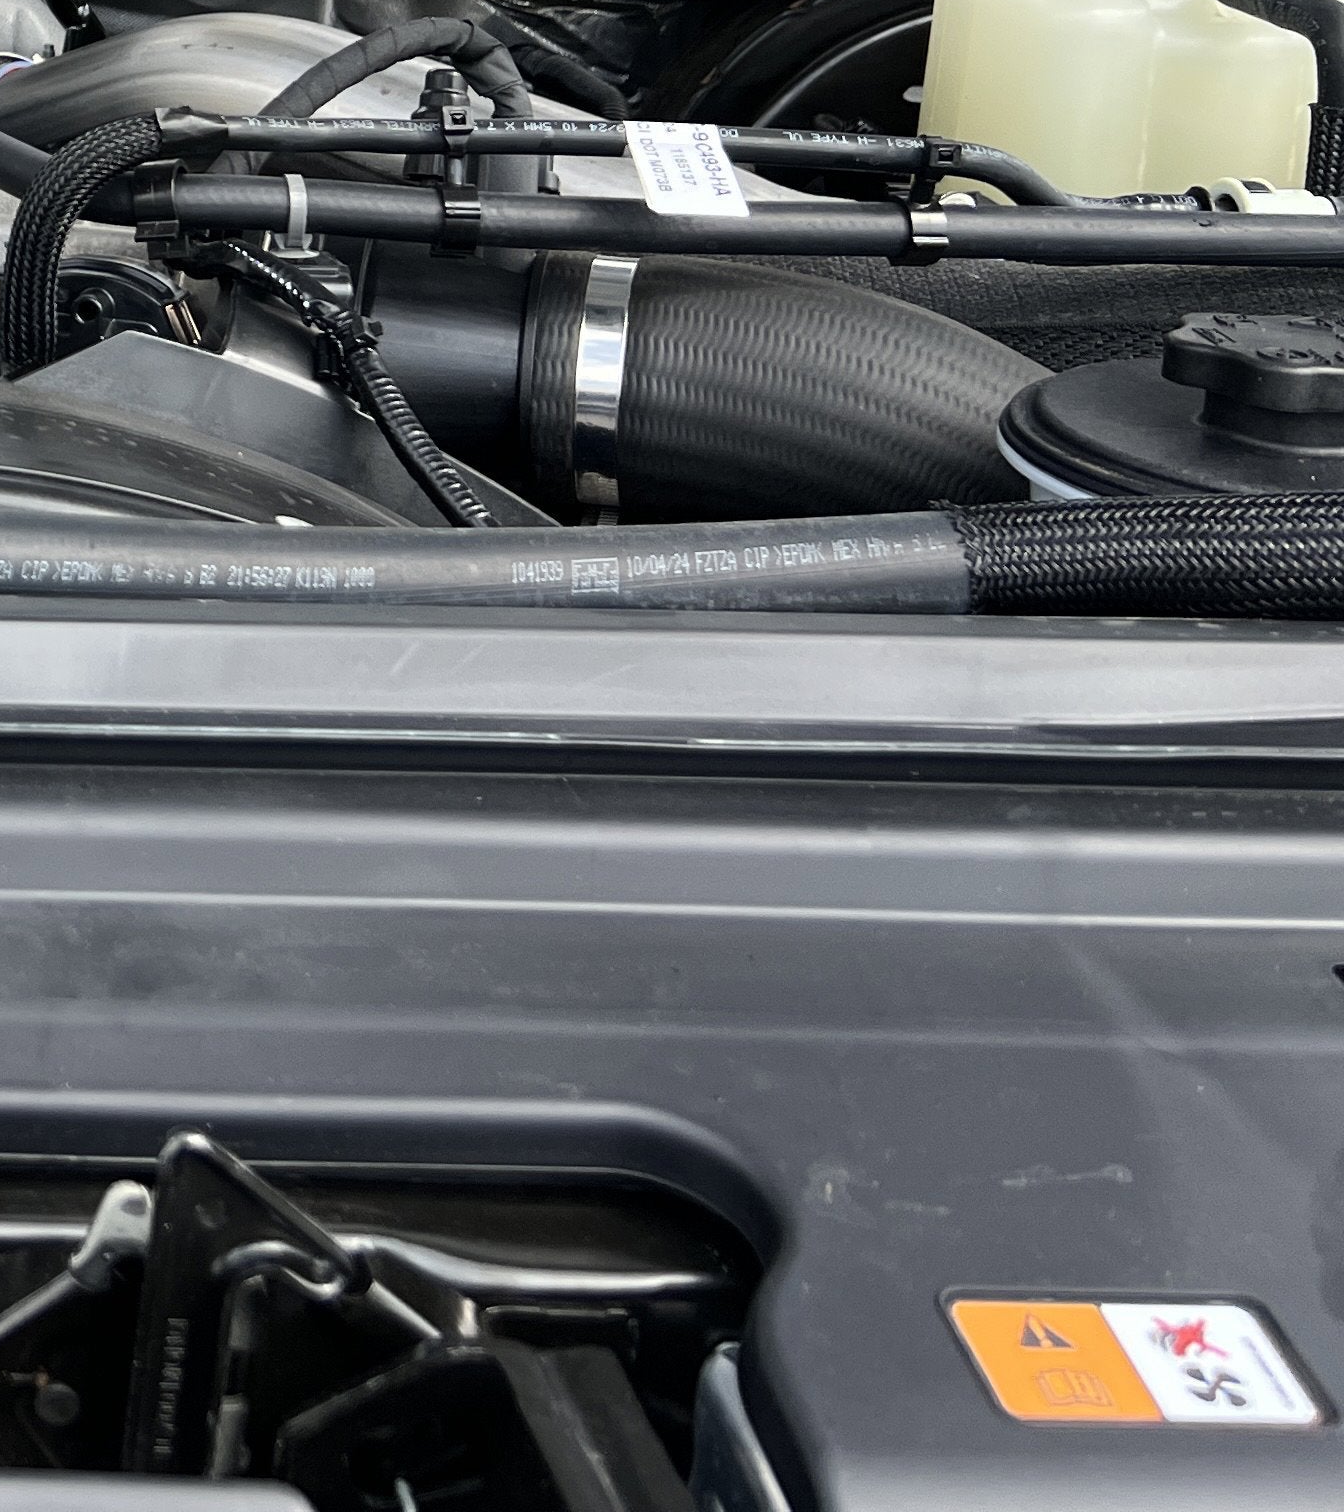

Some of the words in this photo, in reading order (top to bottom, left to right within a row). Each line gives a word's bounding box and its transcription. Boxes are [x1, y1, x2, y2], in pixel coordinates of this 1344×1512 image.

[811, 132, 849, 145] TYPE
[20, 558, 49, 581] CIP
[511, 560, 564, 584] 1041939
[626, 552, 691, 578] 10/04/24
[744, 546, 770, 569] CIP
[831, 538, 861, 561] MEX
